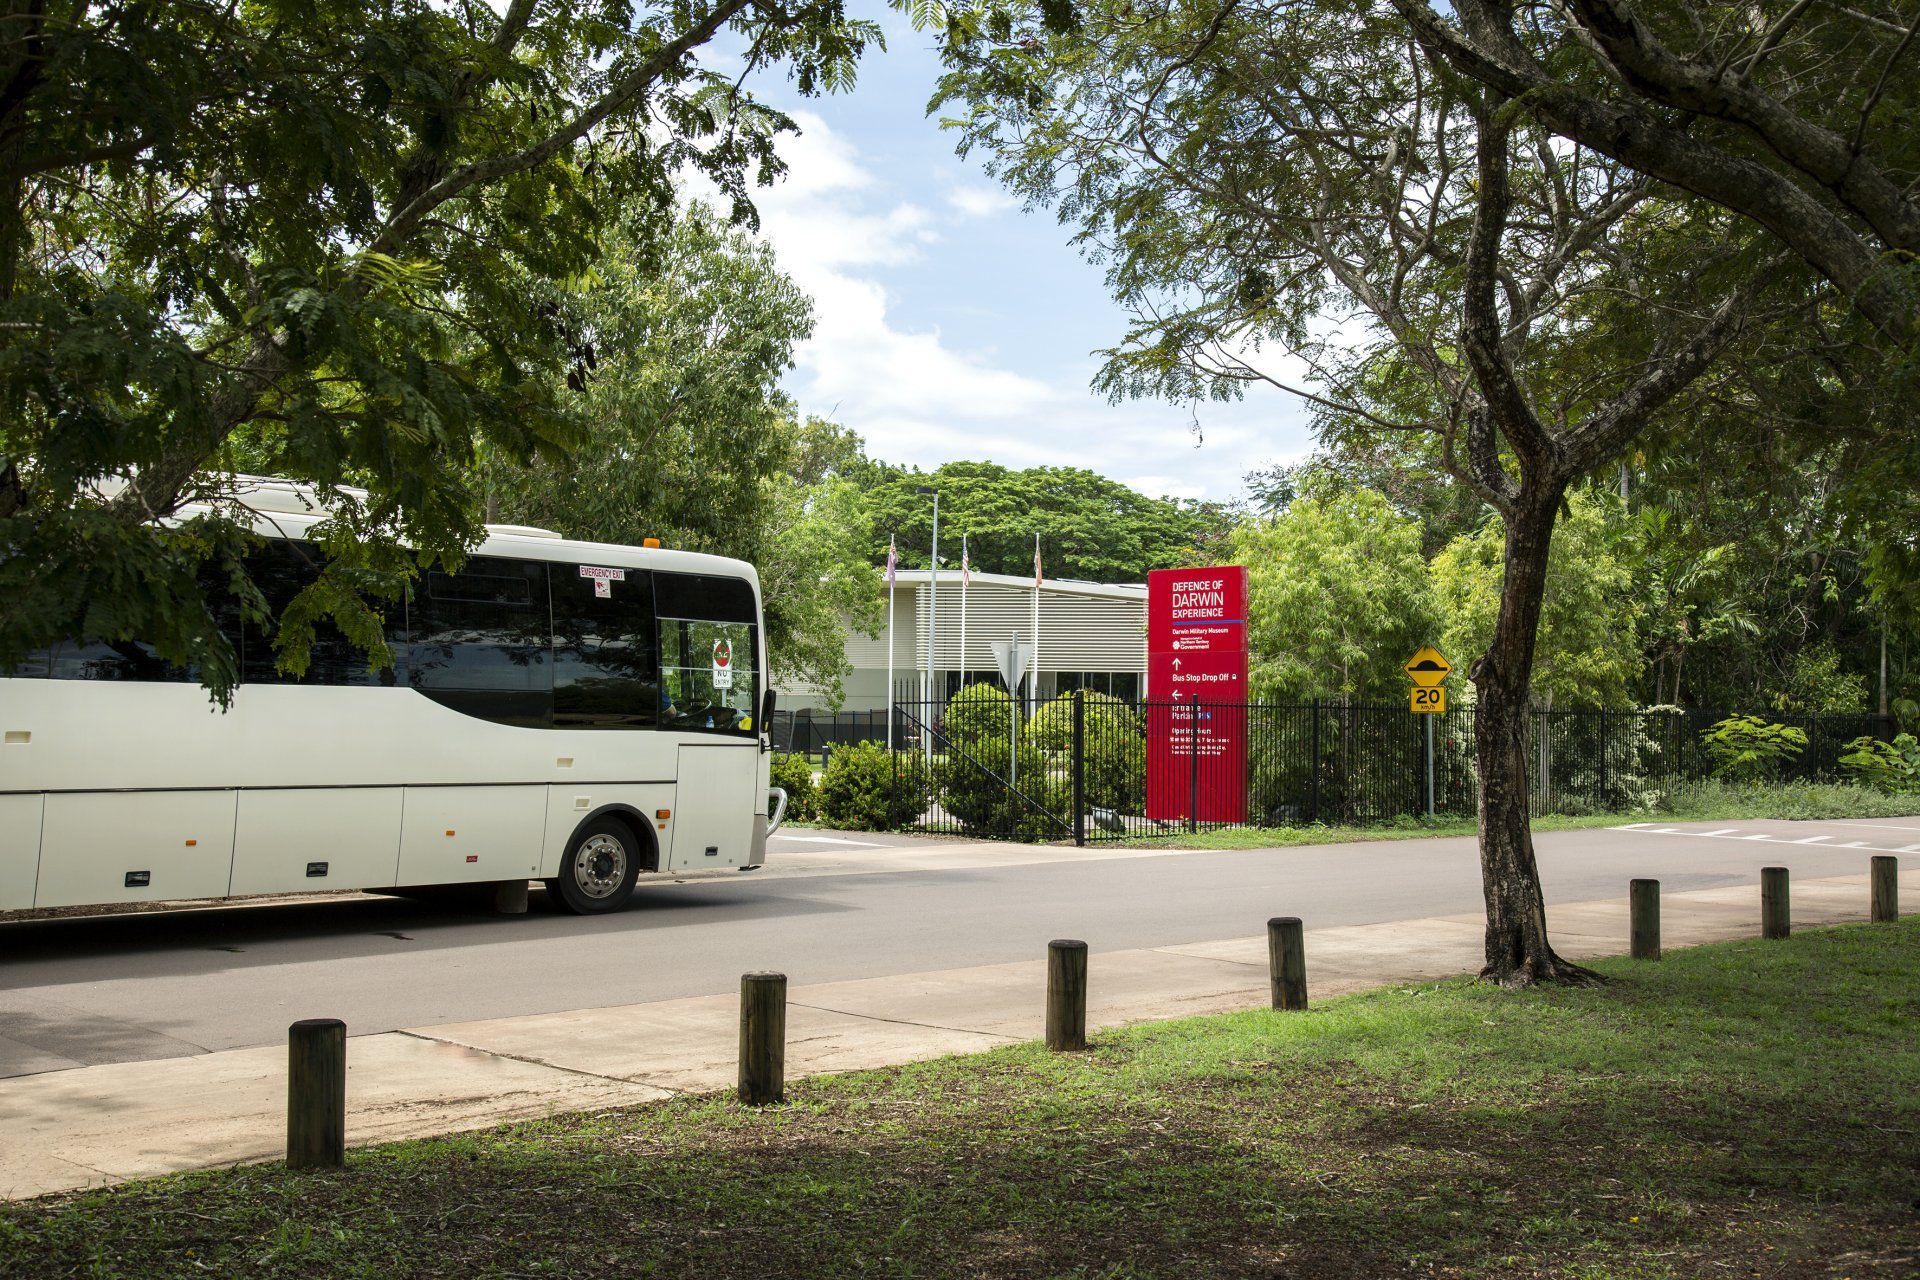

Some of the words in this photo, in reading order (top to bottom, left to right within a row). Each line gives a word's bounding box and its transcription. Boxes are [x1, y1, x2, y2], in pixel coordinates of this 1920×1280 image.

[581, 567, 611, 578] EMERGENCY
[613, 570, 623, 579] EXIT
[1172, 581, 1210, 592] DEFENCE
[1212, 580, 1224, 590] OF
[1172, 591, 1224, 608] DARWIN
[1172, 608, 1224, 619] EXPERIENCE
[1186, 674, 1200, 682] Stop
[1202, 674, 1218, 682] Drop
[1416, 689, 1440, 704] 20
